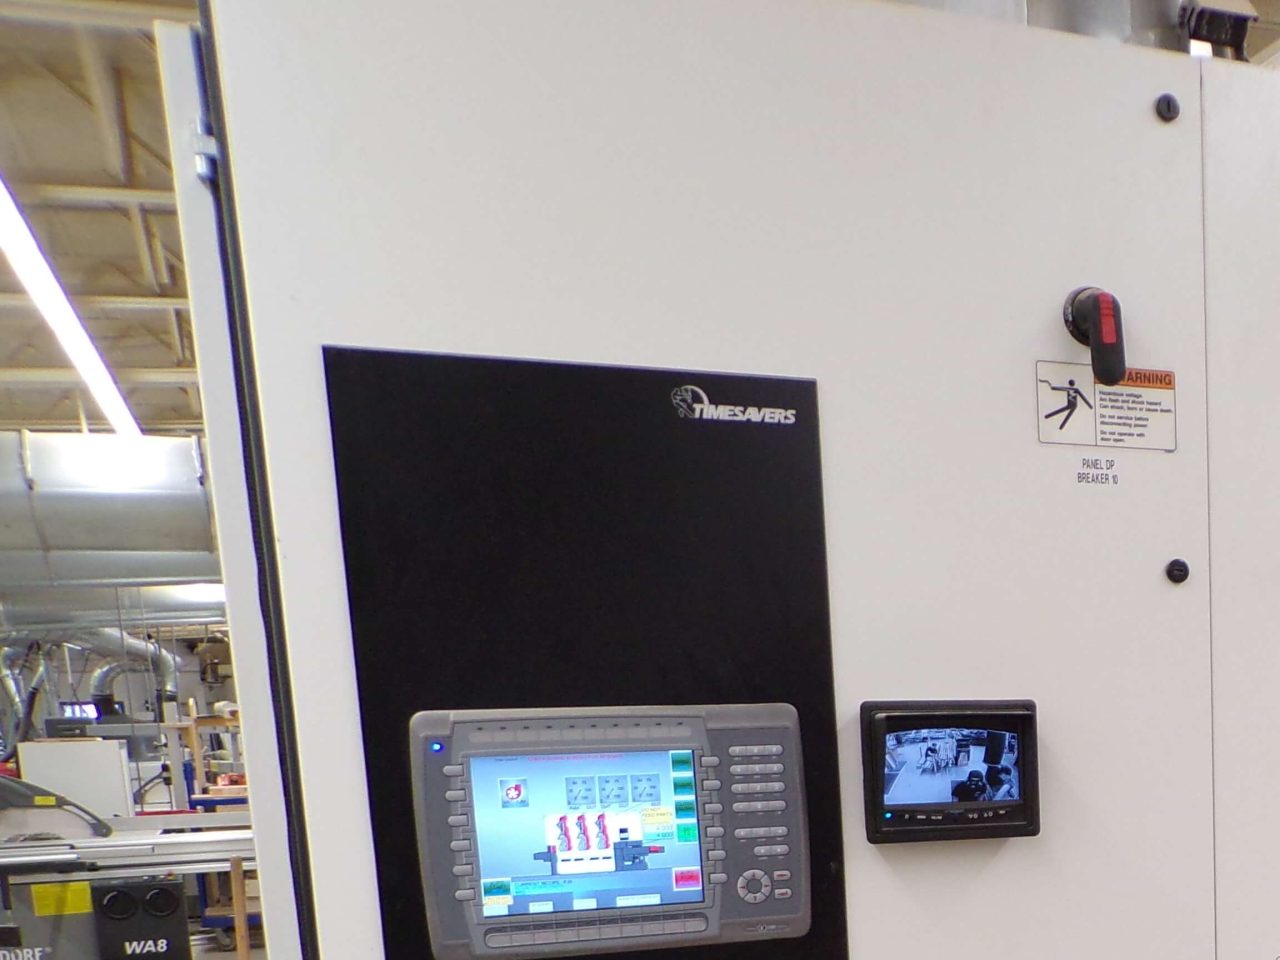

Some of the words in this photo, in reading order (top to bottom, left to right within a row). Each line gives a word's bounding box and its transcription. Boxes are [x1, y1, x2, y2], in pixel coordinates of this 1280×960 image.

[1125, 371, 1173, 386] ARNING
[693, 403, 796, 424] TIMESAVERS
[1082, 458, 1104, 470] PANEL
[1105, 459, 1115, 470] DP
[1077, 472, 1110, 484] BREAKER
[124, 938, 168, 955] WA8
